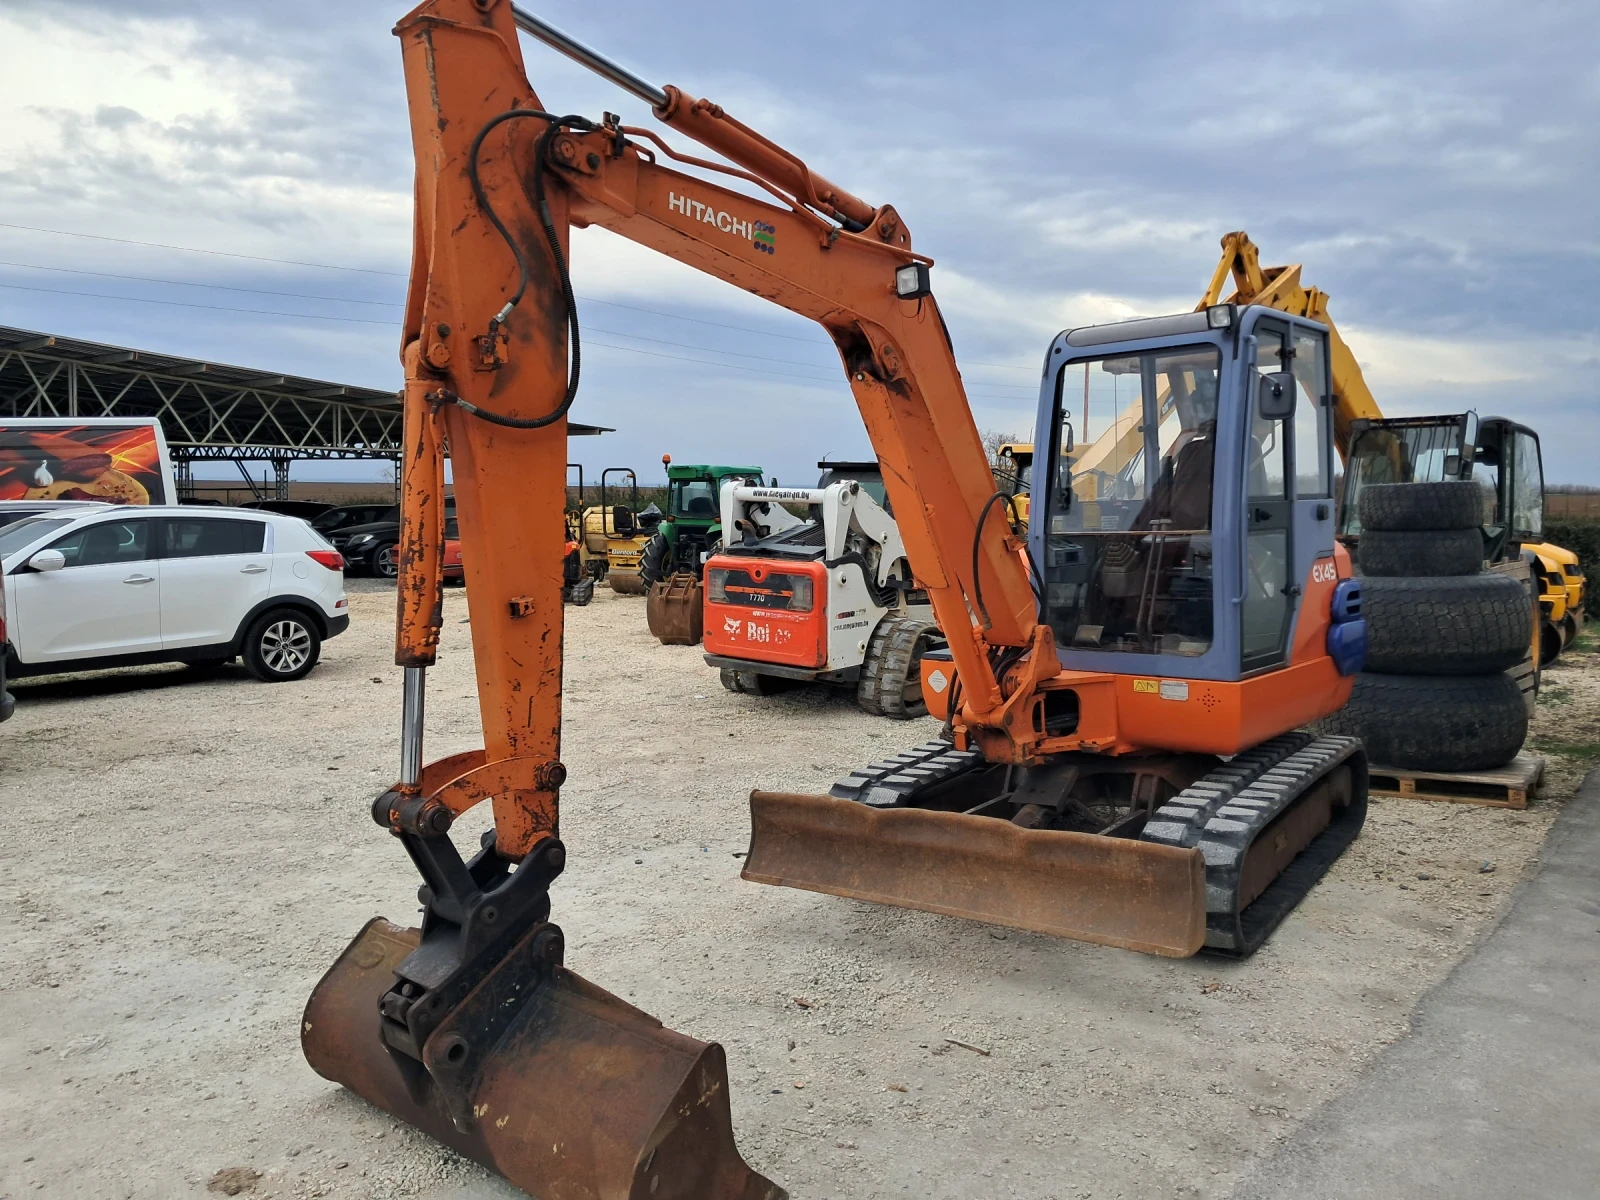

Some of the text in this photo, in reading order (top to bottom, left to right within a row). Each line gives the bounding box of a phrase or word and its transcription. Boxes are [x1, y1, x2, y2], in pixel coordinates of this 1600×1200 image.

[668, 191, 753, 241] HITACHI
[1312, 562, 1337, 583] EX45
[749, 593, 765, 602] T770
